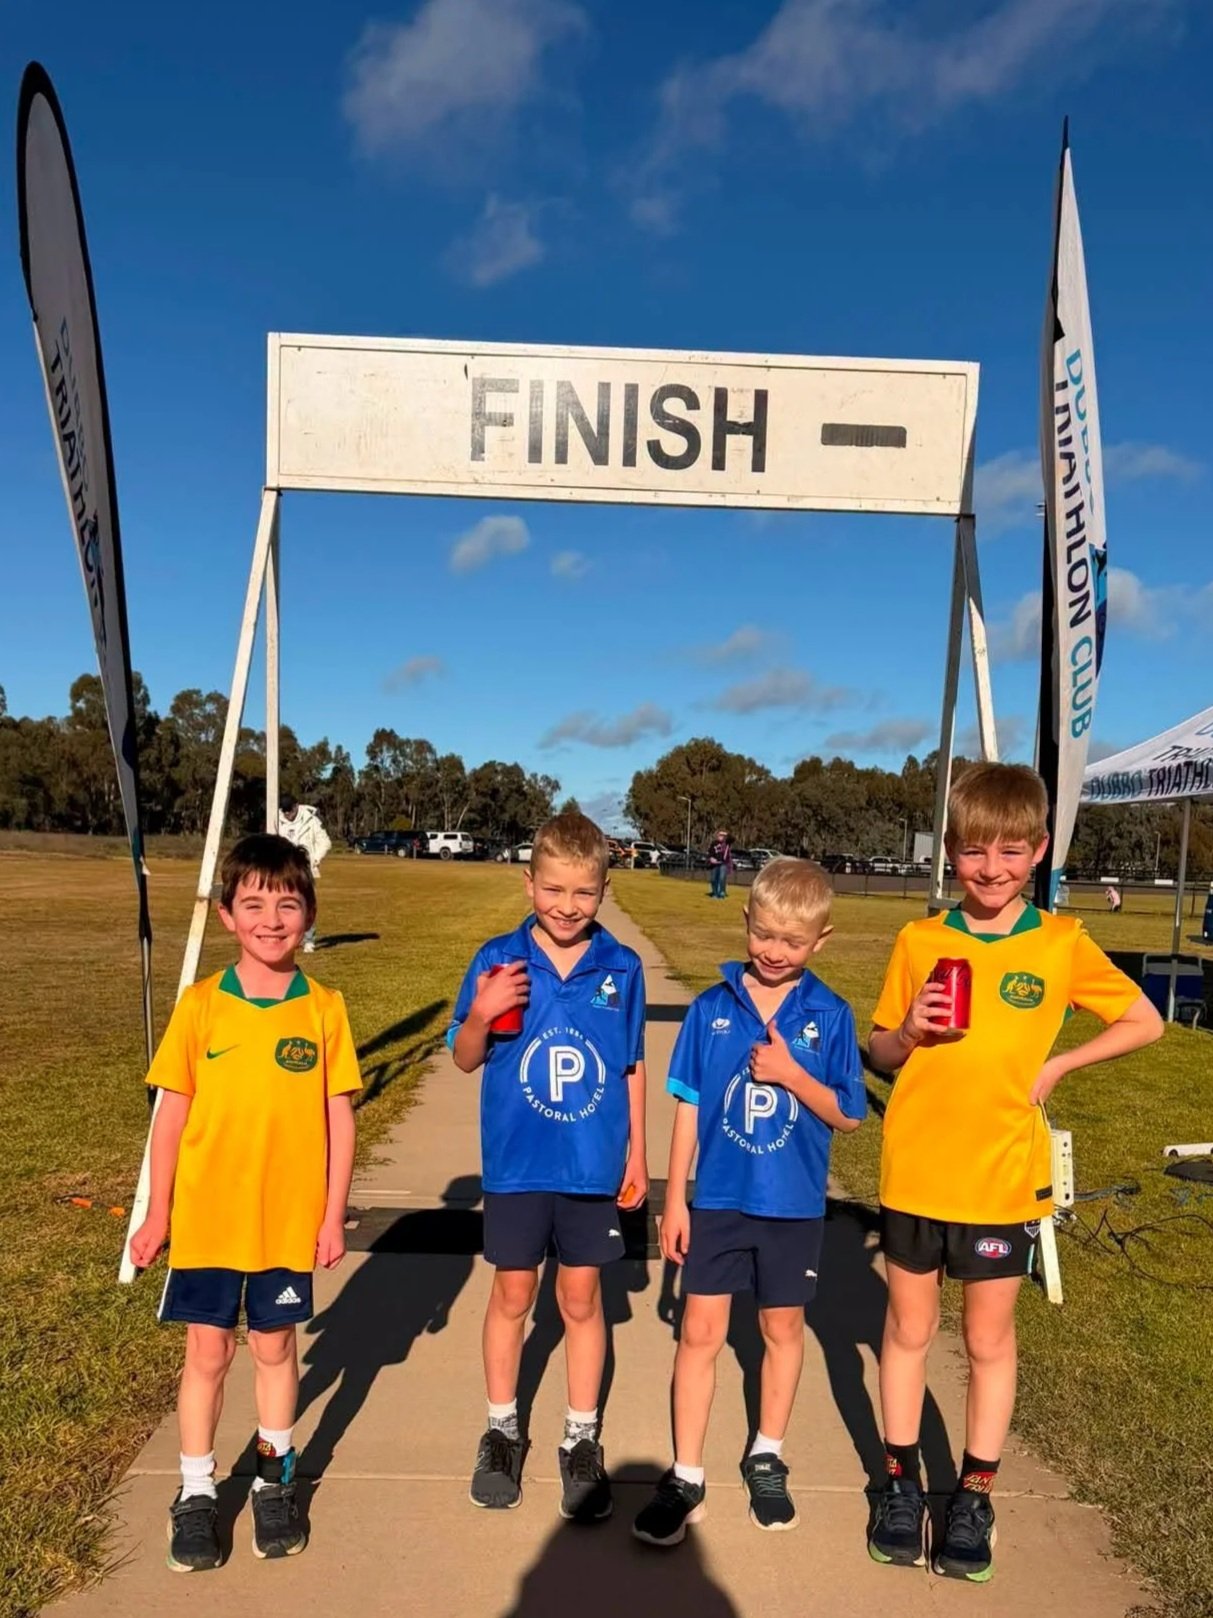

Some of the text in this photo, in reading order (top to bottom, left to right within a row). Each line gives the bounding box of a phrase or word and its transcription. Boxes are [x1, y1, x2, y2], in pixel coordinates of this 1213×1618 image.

[470, 377, 768, 473] FINISH
[1070, 636, 1092, 739] CLUB
[1148, 757, 1213, 797] TRIATHL
[549, 1045, 585, 1102] P
[523, 1086, 605, 1122] PASTORAL HOTEL
[745, 1082, 778, 1135] P
[767, 1123, 794, 1153] HOTEL
[977, 1241, 1009, 1254] AFL
[275, 1296, 302, 1305] adidas
